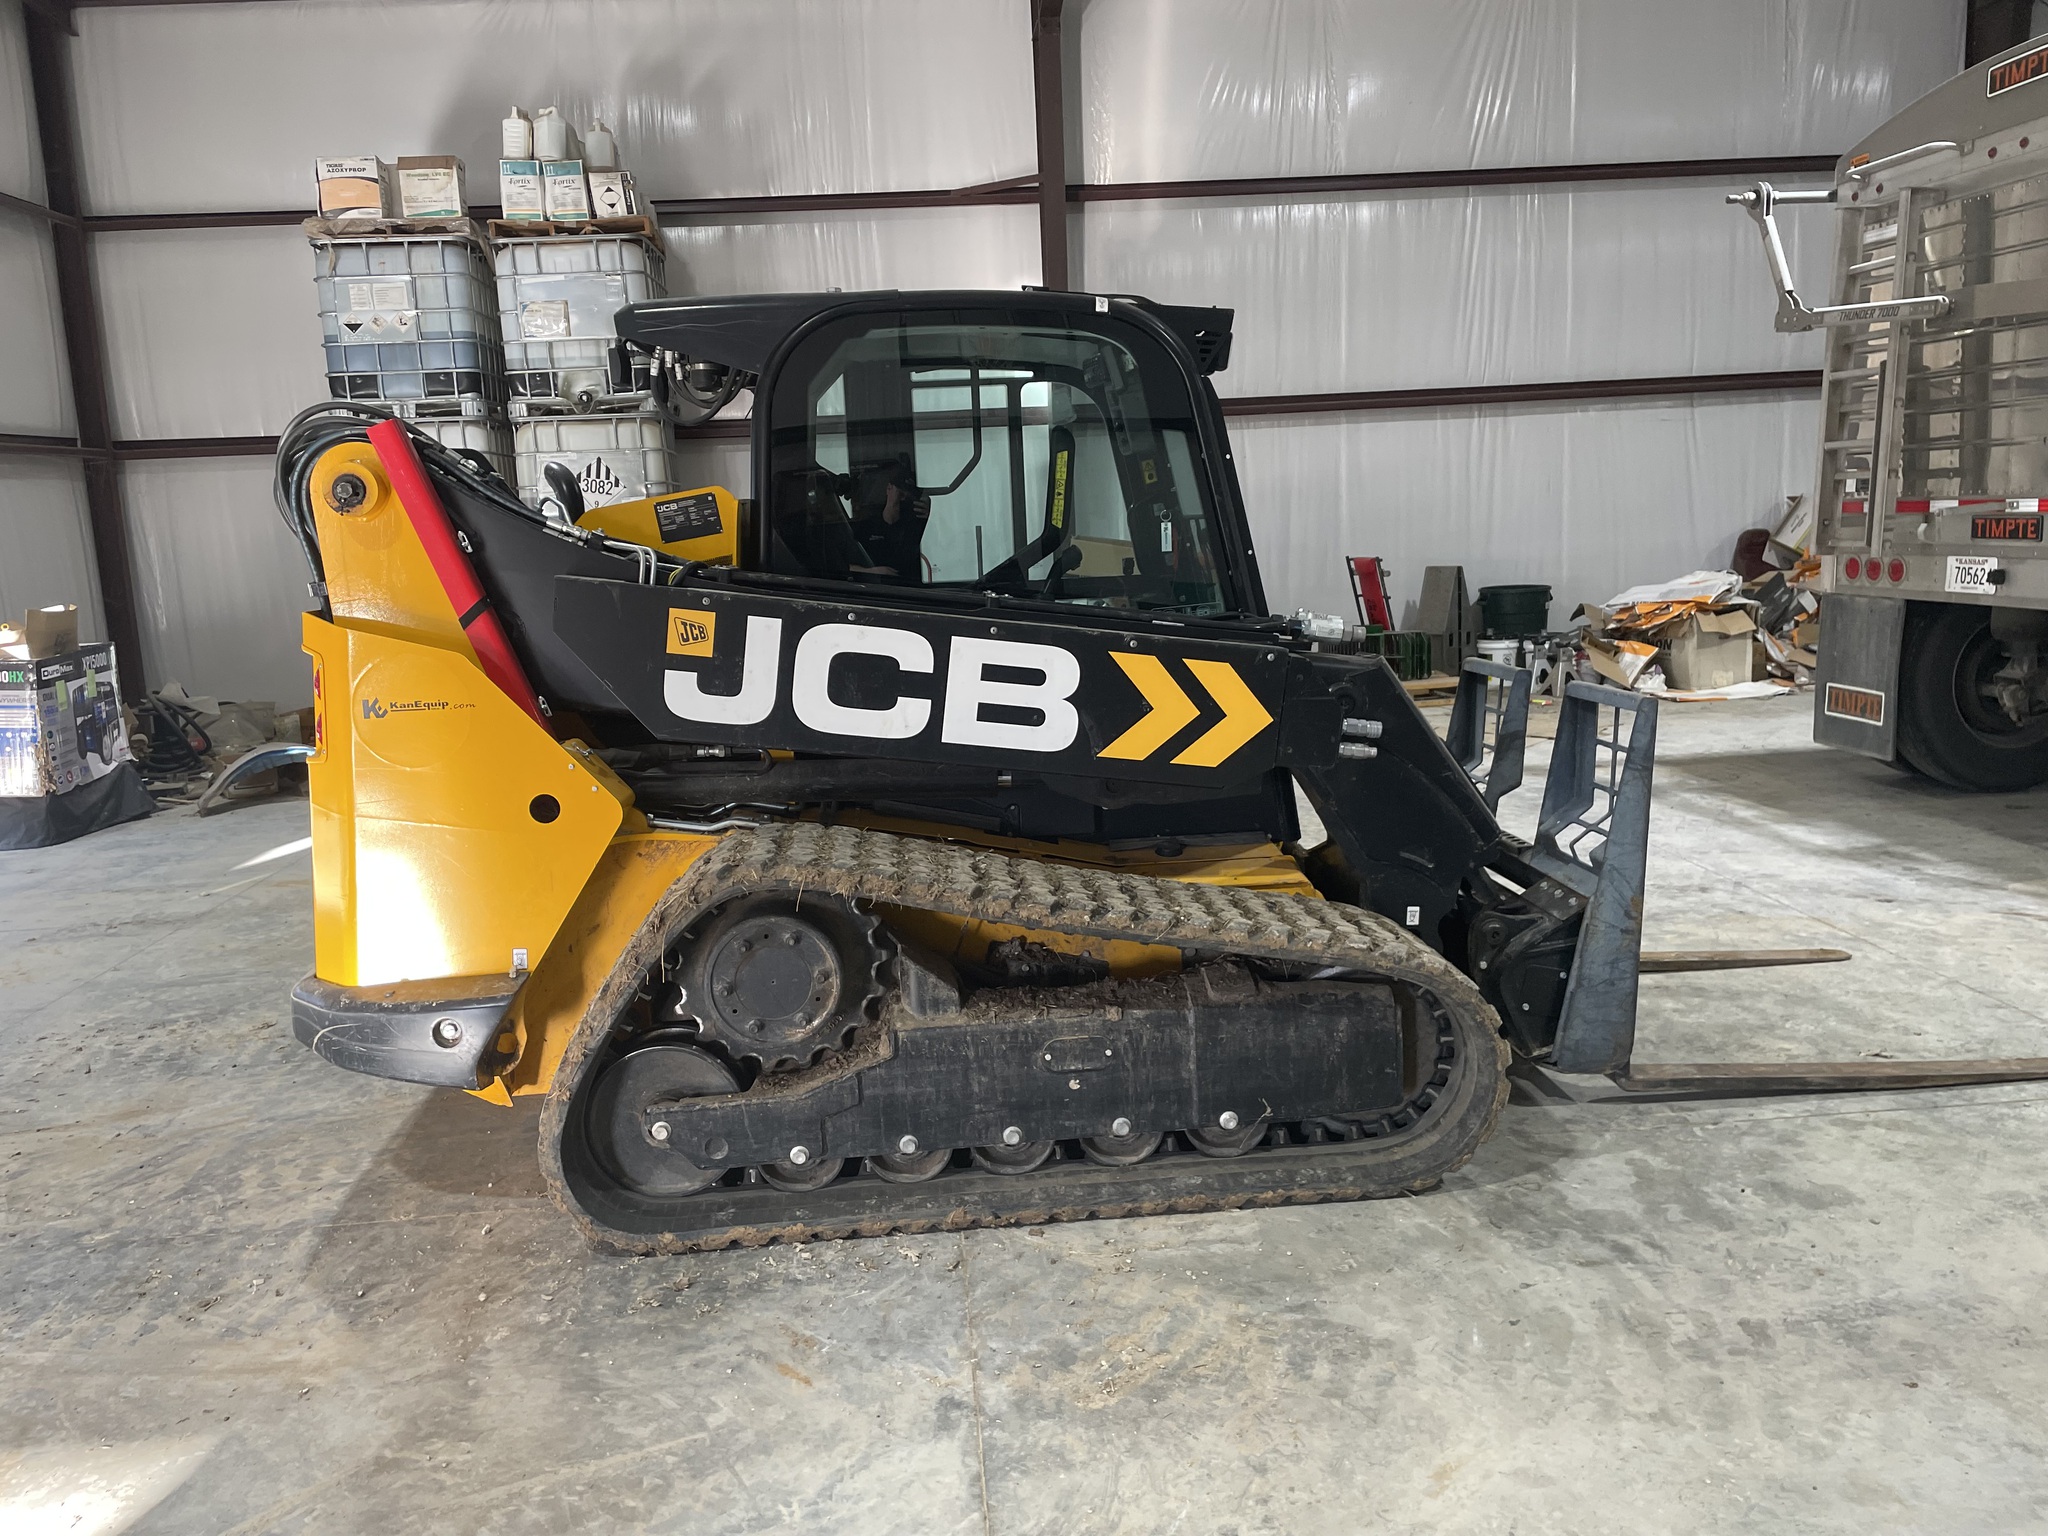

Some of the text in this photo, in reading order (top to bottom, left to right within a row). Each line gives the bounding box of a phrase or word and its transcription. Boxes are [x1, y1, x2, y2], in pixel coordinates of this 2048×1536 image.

[1840, 306, 1900, 321] THUNDER 7000
[582, 479, 613, 496] 3082
[656, 503, 678, 512] JCB
[1975, 519, 2038, 538] TIMPTE
[1955, 566, 1995, 585] 70562
[680, 621, 707, 642] JCB
[42, 664, 74, 678] DuroMax
[664, 615, 1080, 752] JCB
[1830, 687, 1881, 721] TIMPTE
